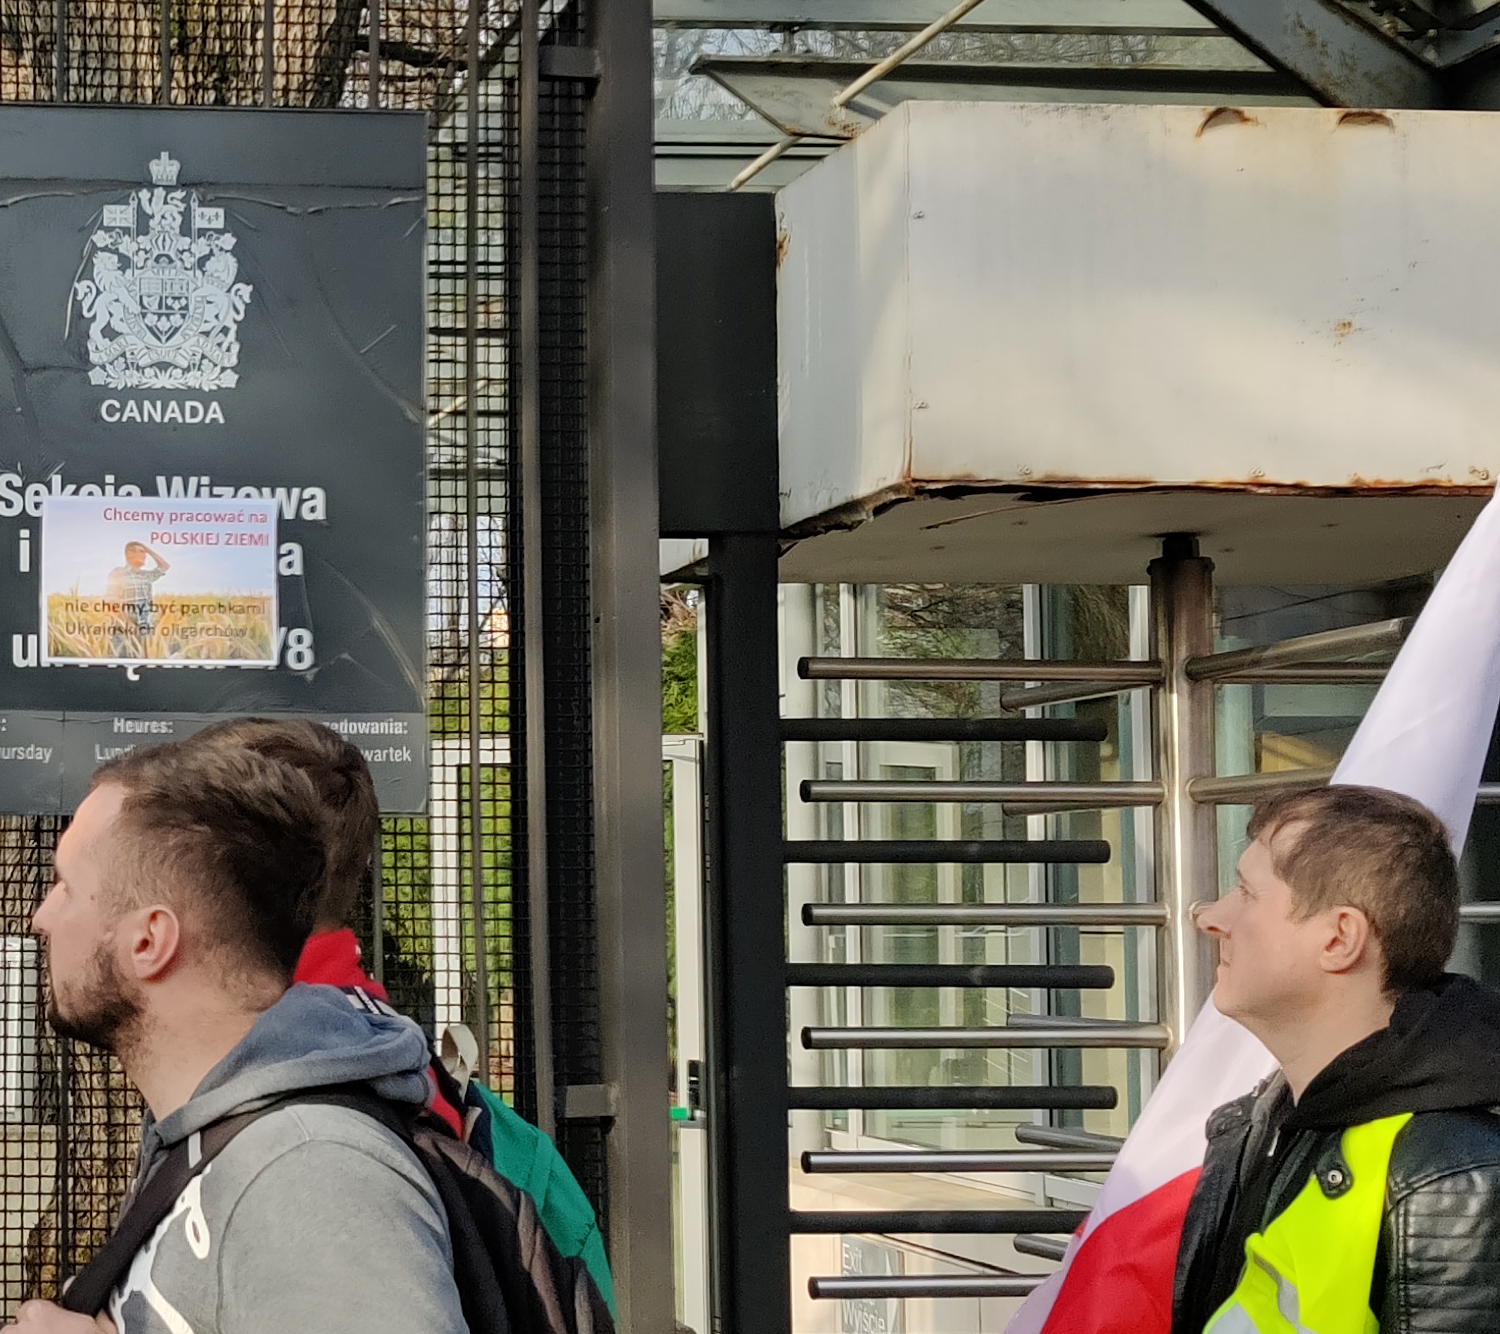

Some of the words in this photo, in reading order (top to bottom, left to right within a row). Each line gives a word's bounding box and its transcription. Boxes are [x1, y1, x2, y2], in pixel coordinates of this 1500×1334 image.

[100, 399, 226, 424] CANADA
[103, 507, 164, 525] Chcemy
[169, 508, 244, 525] pracować
[248, 511, 268, 523] na
[151, 531, 220, 546] POLSKIEJ
[224, 532, 269, 547] ZIEMI
[19, 528, 31, 573] i
[64, 598, 89, 613] nie
[93, 599, 145, 616] chemy
[150, 599, 177, 616] być
[65, 621, 156, 637] Ukraińskich
[113, 717, 174, 734] Heures:
[361, 744, 412, 763] wartek
[842, 1242, 863, 1275] Exit
[841, 1299, 886, 1334] Wyjście
